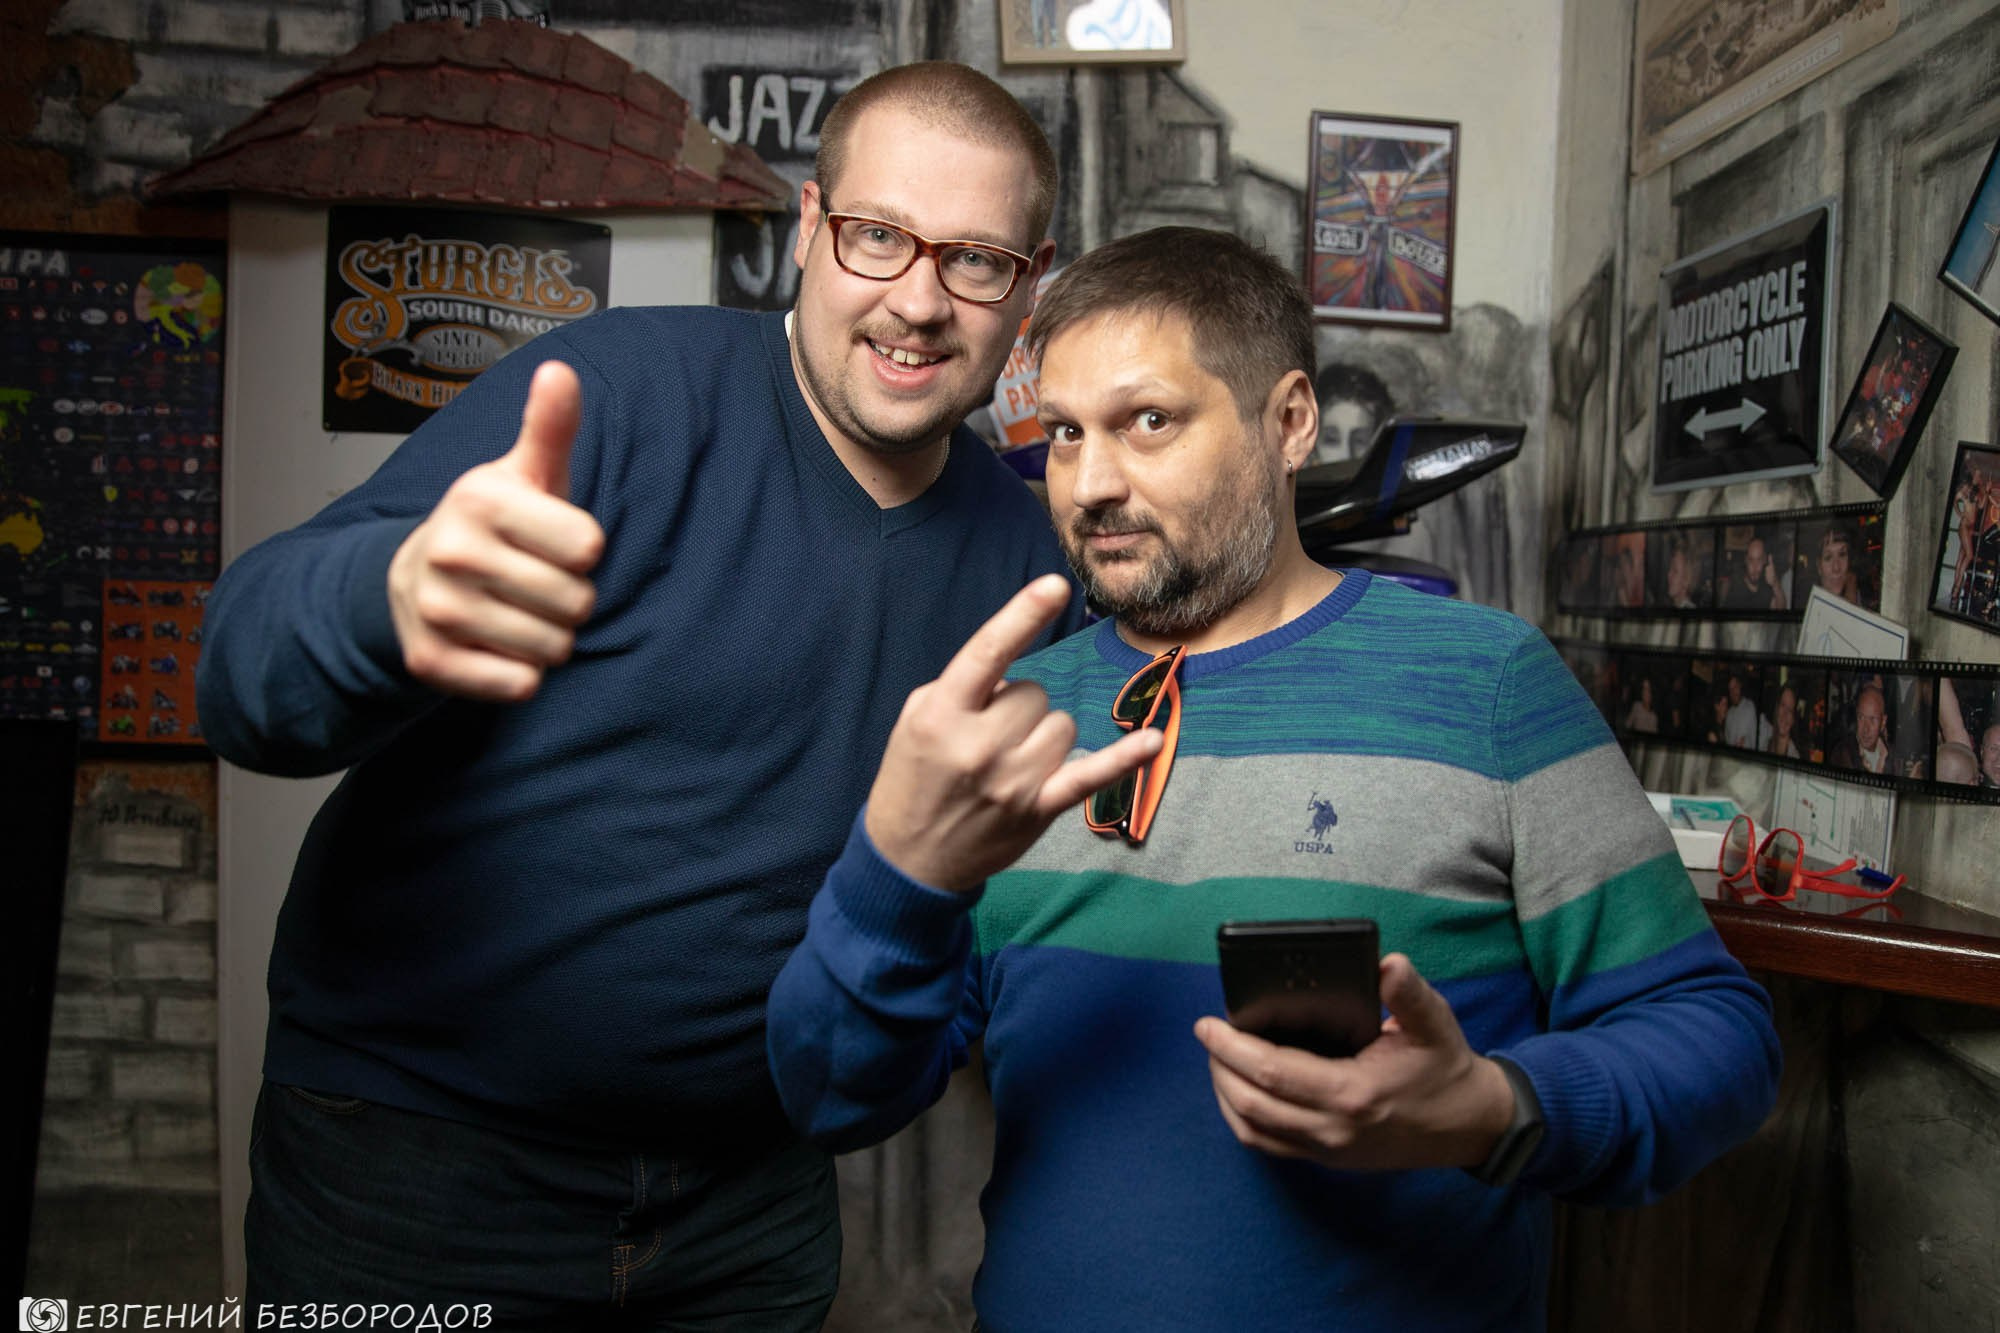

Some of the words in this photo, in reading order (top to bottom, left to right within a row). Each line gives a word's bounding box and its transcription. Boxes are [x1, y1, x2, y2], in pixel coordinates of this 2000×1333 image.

[331, 234, 597, 350] STURGIS
[408, 300, 486, 327] SOUTH
[1664, 261, 1807, 354] MOTORCYCLE
[1660, 336, 1744, 404] PARKING
[1746, 317, 1807, 380] ONLY
[1294, 841, 1334, 855] USPA
